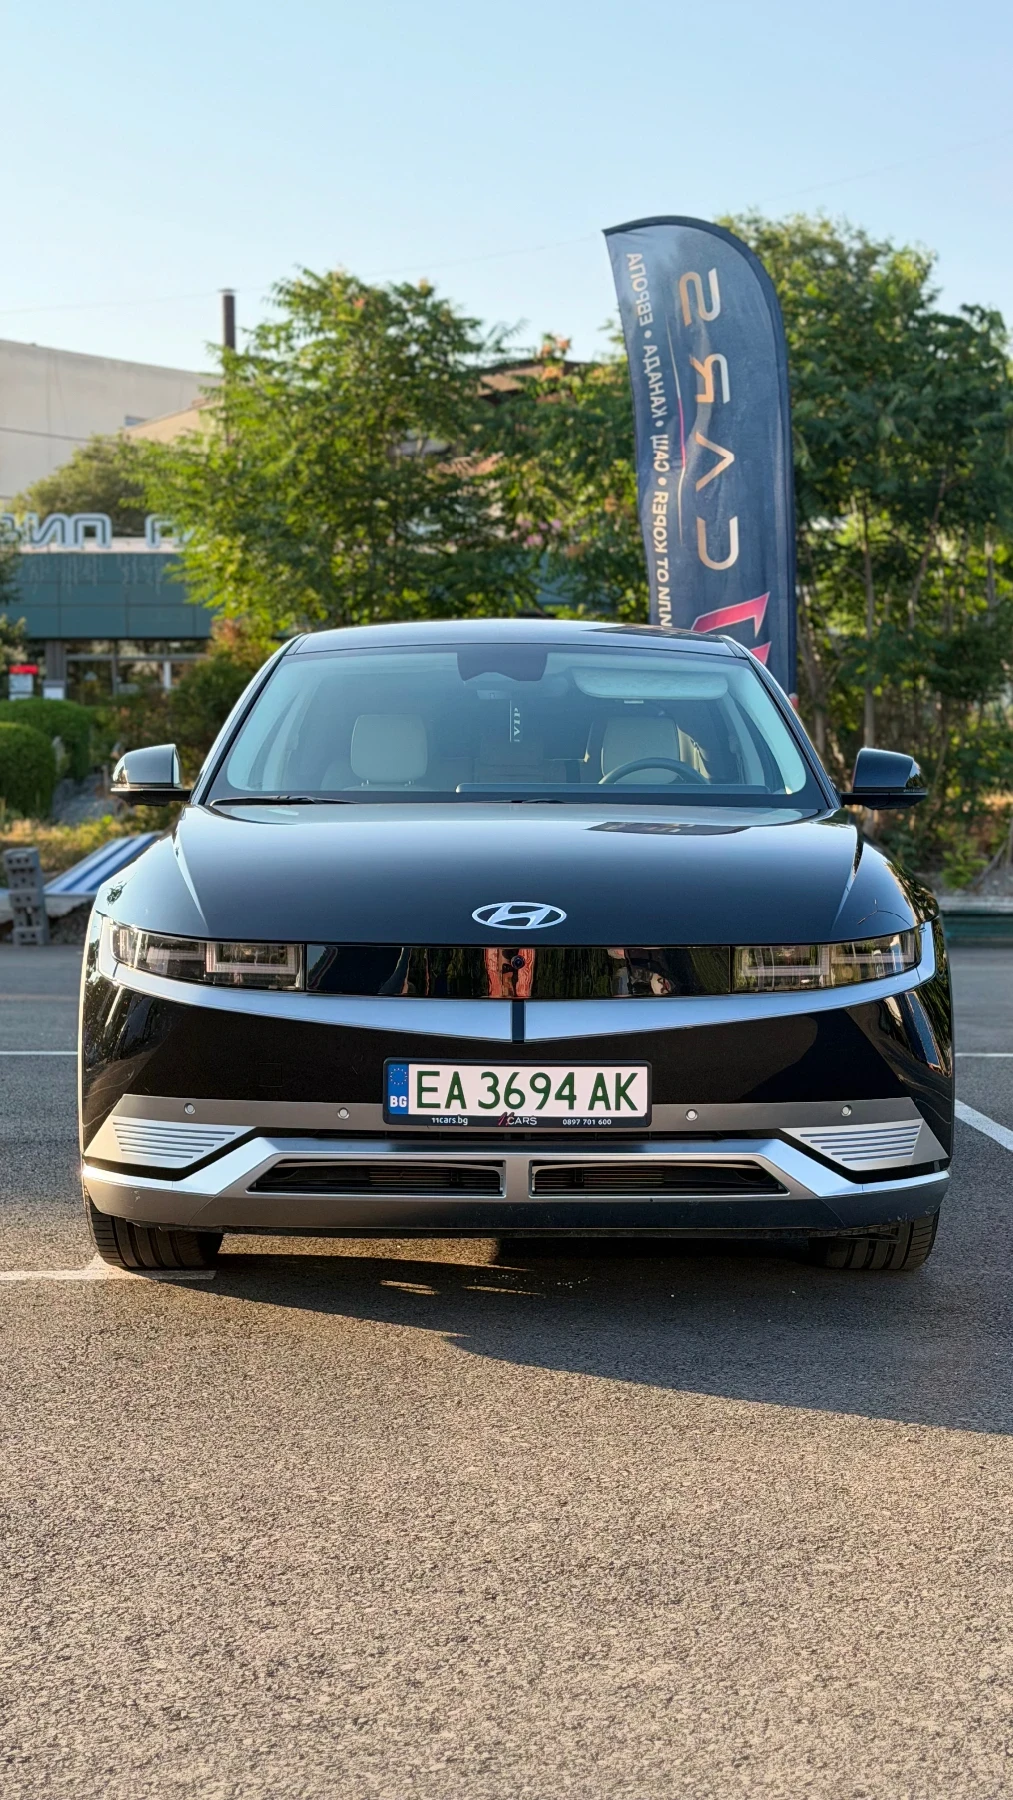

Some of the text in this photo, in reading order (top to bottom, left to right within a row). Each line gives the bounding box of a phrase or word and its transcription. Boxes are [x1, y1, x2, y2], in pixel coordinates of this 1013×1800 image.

[513, 707, 521, 737] VIP
[416, 1070, 639, 1111] EA 3694 AK
[389, 1095, 408, 1108] BG
[431, 1116, 468, 1126] 11cars.bg
